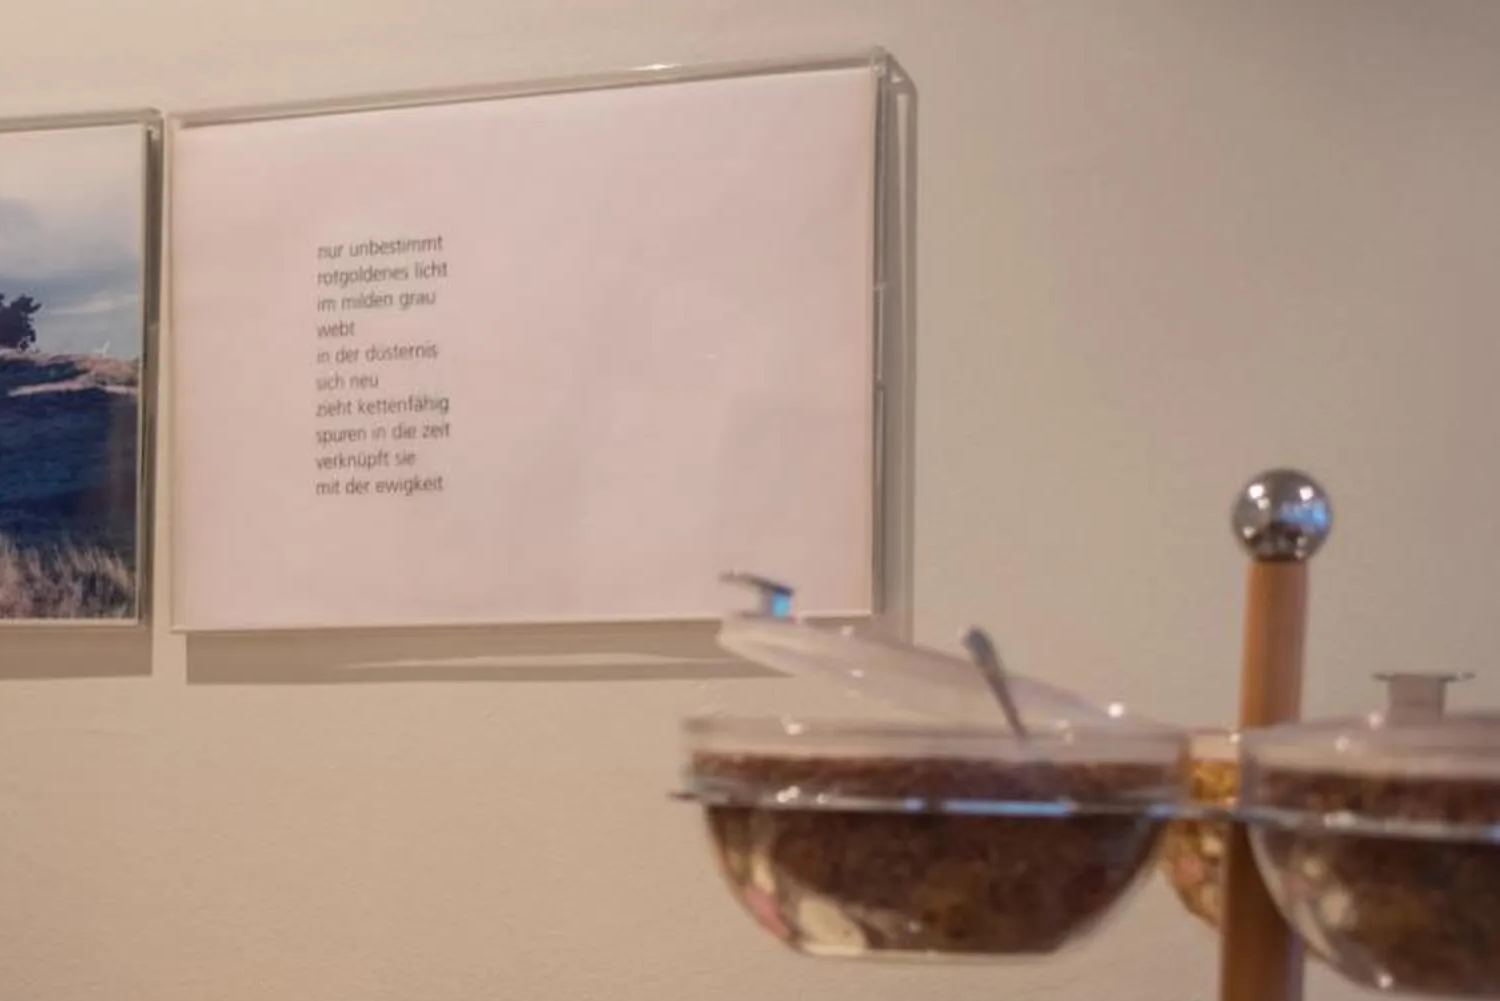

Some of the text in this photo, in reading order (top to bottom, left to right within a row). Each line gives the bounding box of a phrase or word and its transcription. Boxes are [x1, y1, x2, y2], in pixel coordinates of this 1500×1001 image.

[318, 236, 443, 259] nur unbestimmt
[318, 260, 448, 289] rotgoldenes licht
[318, 291, 437, 312] im milden grau
[317, 320, 355, 337] webt
[317, 347, 331, 364] in
[335, 345, 360, 364] der
[316, 372, 379, 391] sich neu
[316, 399, 352, 417] zieht
[316, 421, 450, 447] spuren in die zeit
[395, 450, 416, 467] sie
[316, 475, 444, 497] mit der ewigkeit
